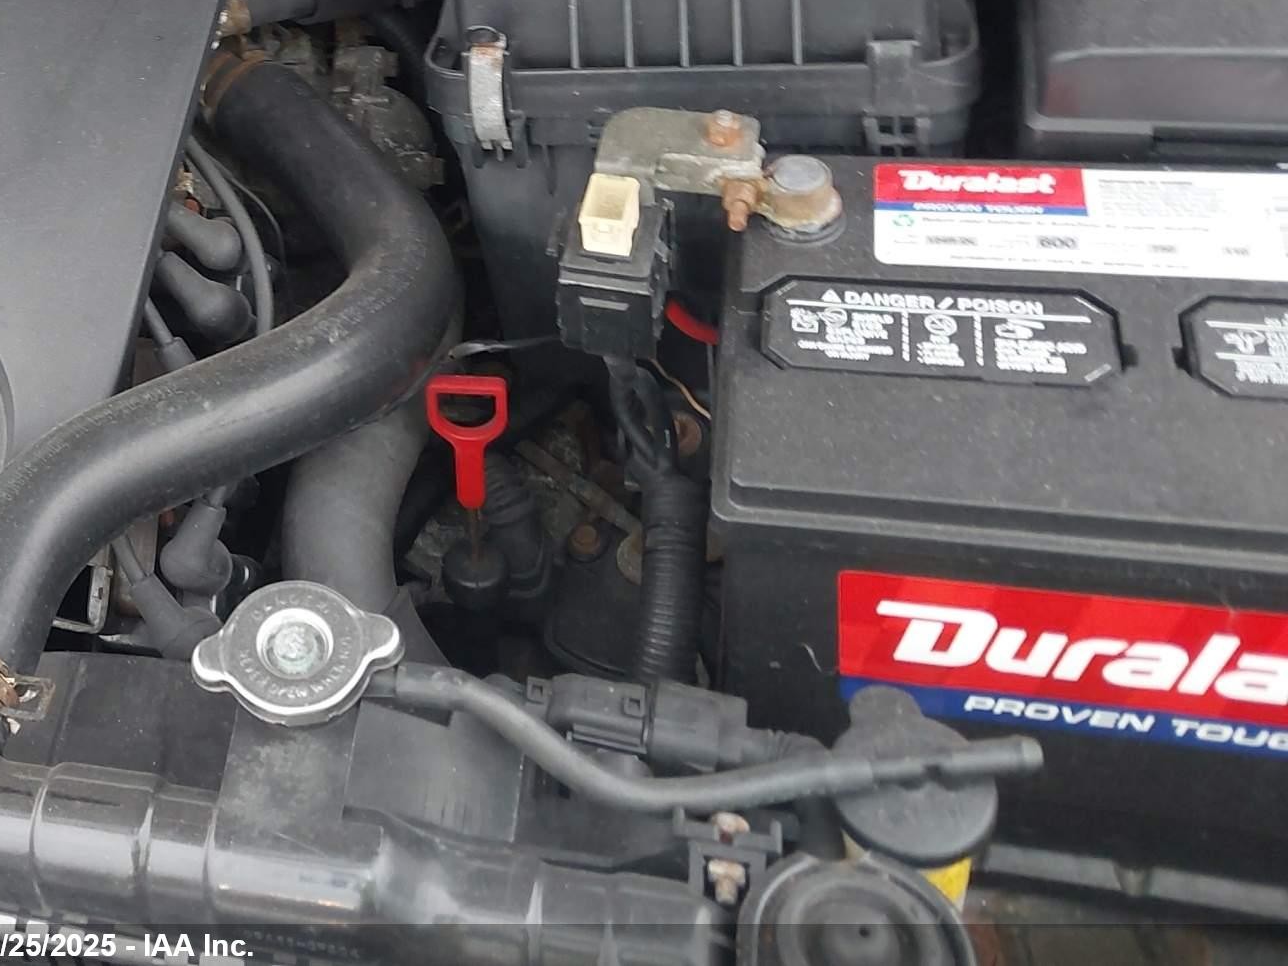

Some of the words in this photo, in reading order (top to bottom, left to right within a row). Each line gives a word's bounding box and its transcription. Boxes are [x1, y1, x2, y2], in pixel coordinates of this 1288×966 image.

[898, 170, 1057, 194] Duralast
[1038, 235, 1077, 249] 600
[844, 290, 935, 310] DANGER
[957, 297, 1044, 316] POISON
[876, 599, 1288, 706] Durala
[964, 695, 1156, 733] PROVEN
